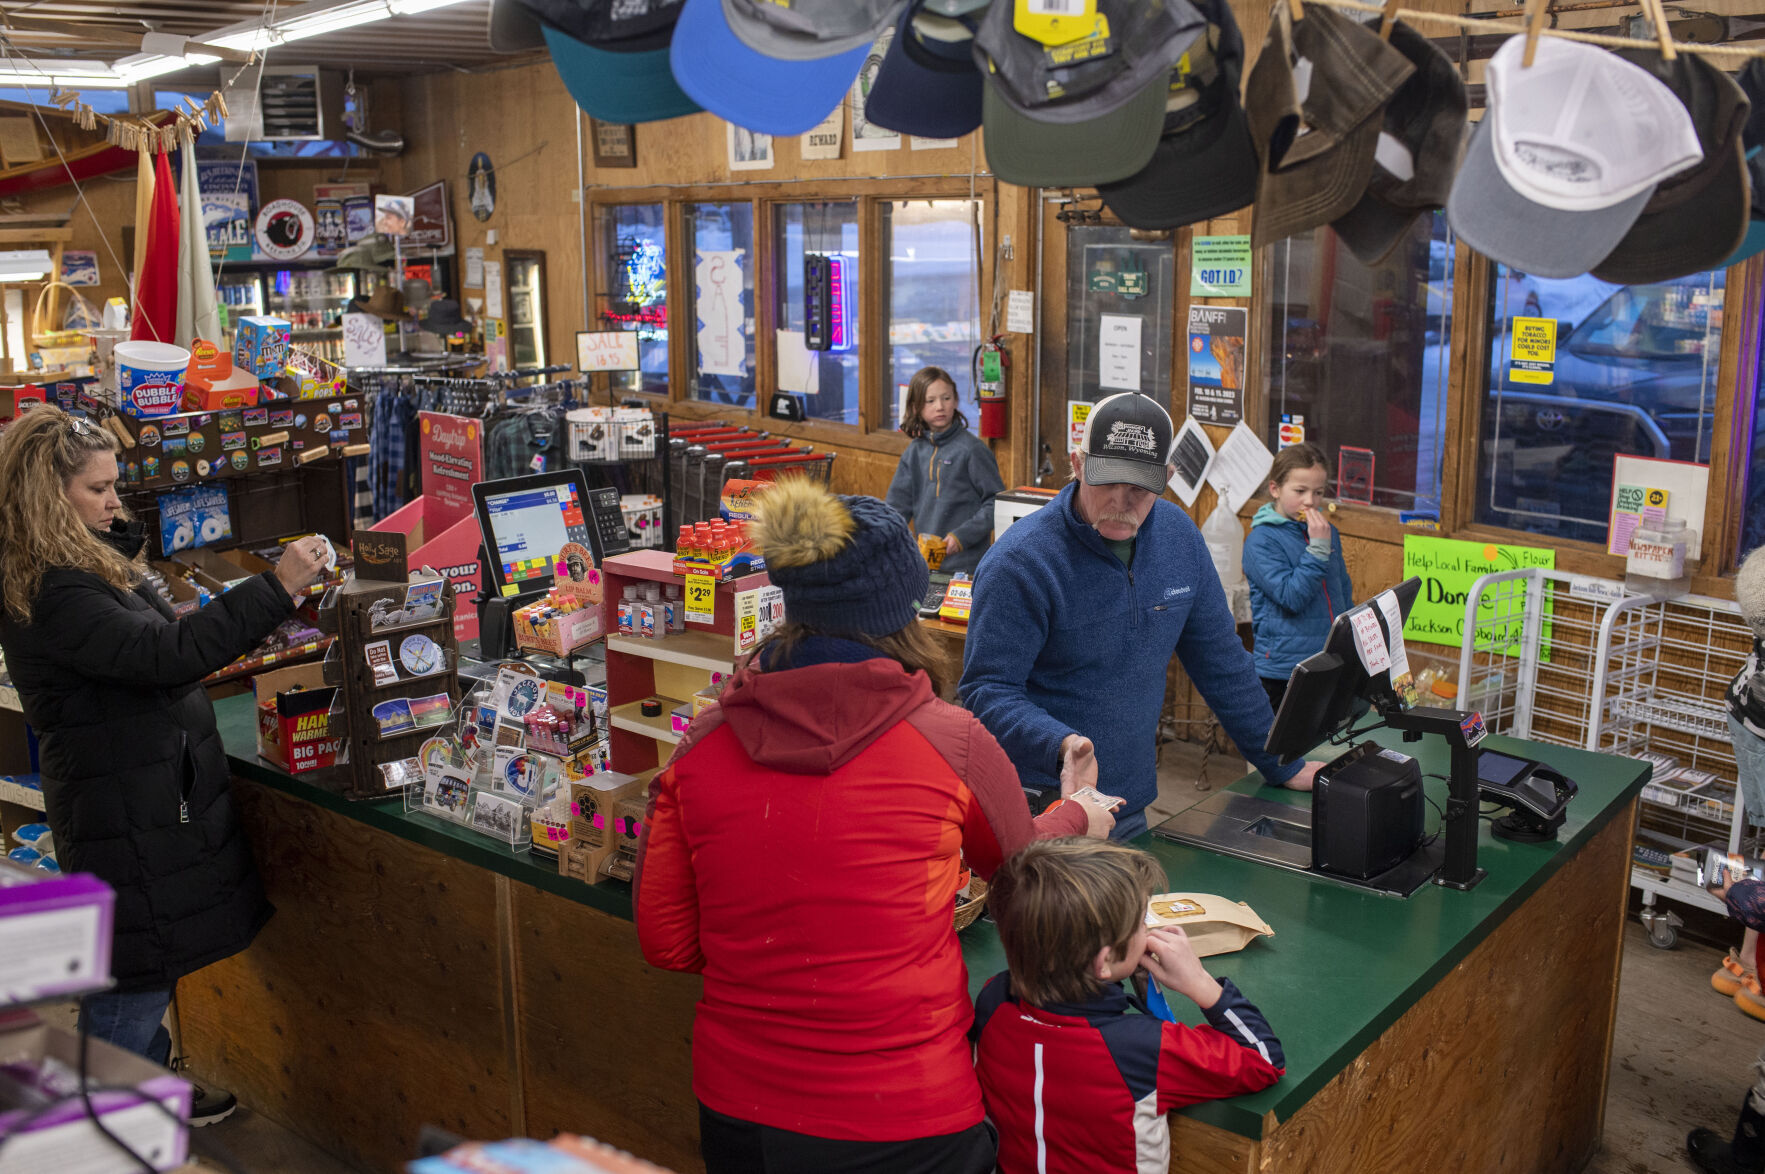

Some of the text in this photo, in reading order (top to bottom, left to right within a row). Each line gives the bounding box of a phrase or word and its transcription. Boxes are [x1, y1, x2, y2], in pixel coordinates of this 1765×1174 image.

[809, 134, 833, 146] REWARD
[1201, 269, 1221, 284] GOT
[1191, 309, 1224, 324] BANFF
[587, 332, 624, 352] SALE
[135, 387, 177, 398] DUBBLE
[313, 388, 333, 397] POPS
[137, 395, 178, 407] BUBBLE
[432, 424, 467, 450] Daytrip
[1103, 443, 1158, 458] Wilson, Wyoming
[429, 451, 473, 471] Mood-Elevating
[432, 465, 470, 481] Refreshment
[358, 542, 399, 558] Holly Sage
[1629, 537, 1674, 557] NEWSPAPER
[1407, 552, 1433, 571] Help
[1435, 552, 1460, 571] Local
[1523, 551, 1551, 566] Flour
[440, 562, 477, 578] your
[565, 585, 593, 596] LIP BALM
[1427, 577, 1494, 610] Done
[1408, 616, 1508, 642] Jackson Cpboard
[741, 635, 755, 645] Card
[376, 646, 386, 654] Not
[511, 679, 539, 701] JACKSON
[509, 705, 527, 718] HOLE
[296, 712, 329, 731] HAN
[292, 727, 330, 743] WARME
[293, 740, 340, 760] BIG PAC
[296, 761, 305, 770] 10
